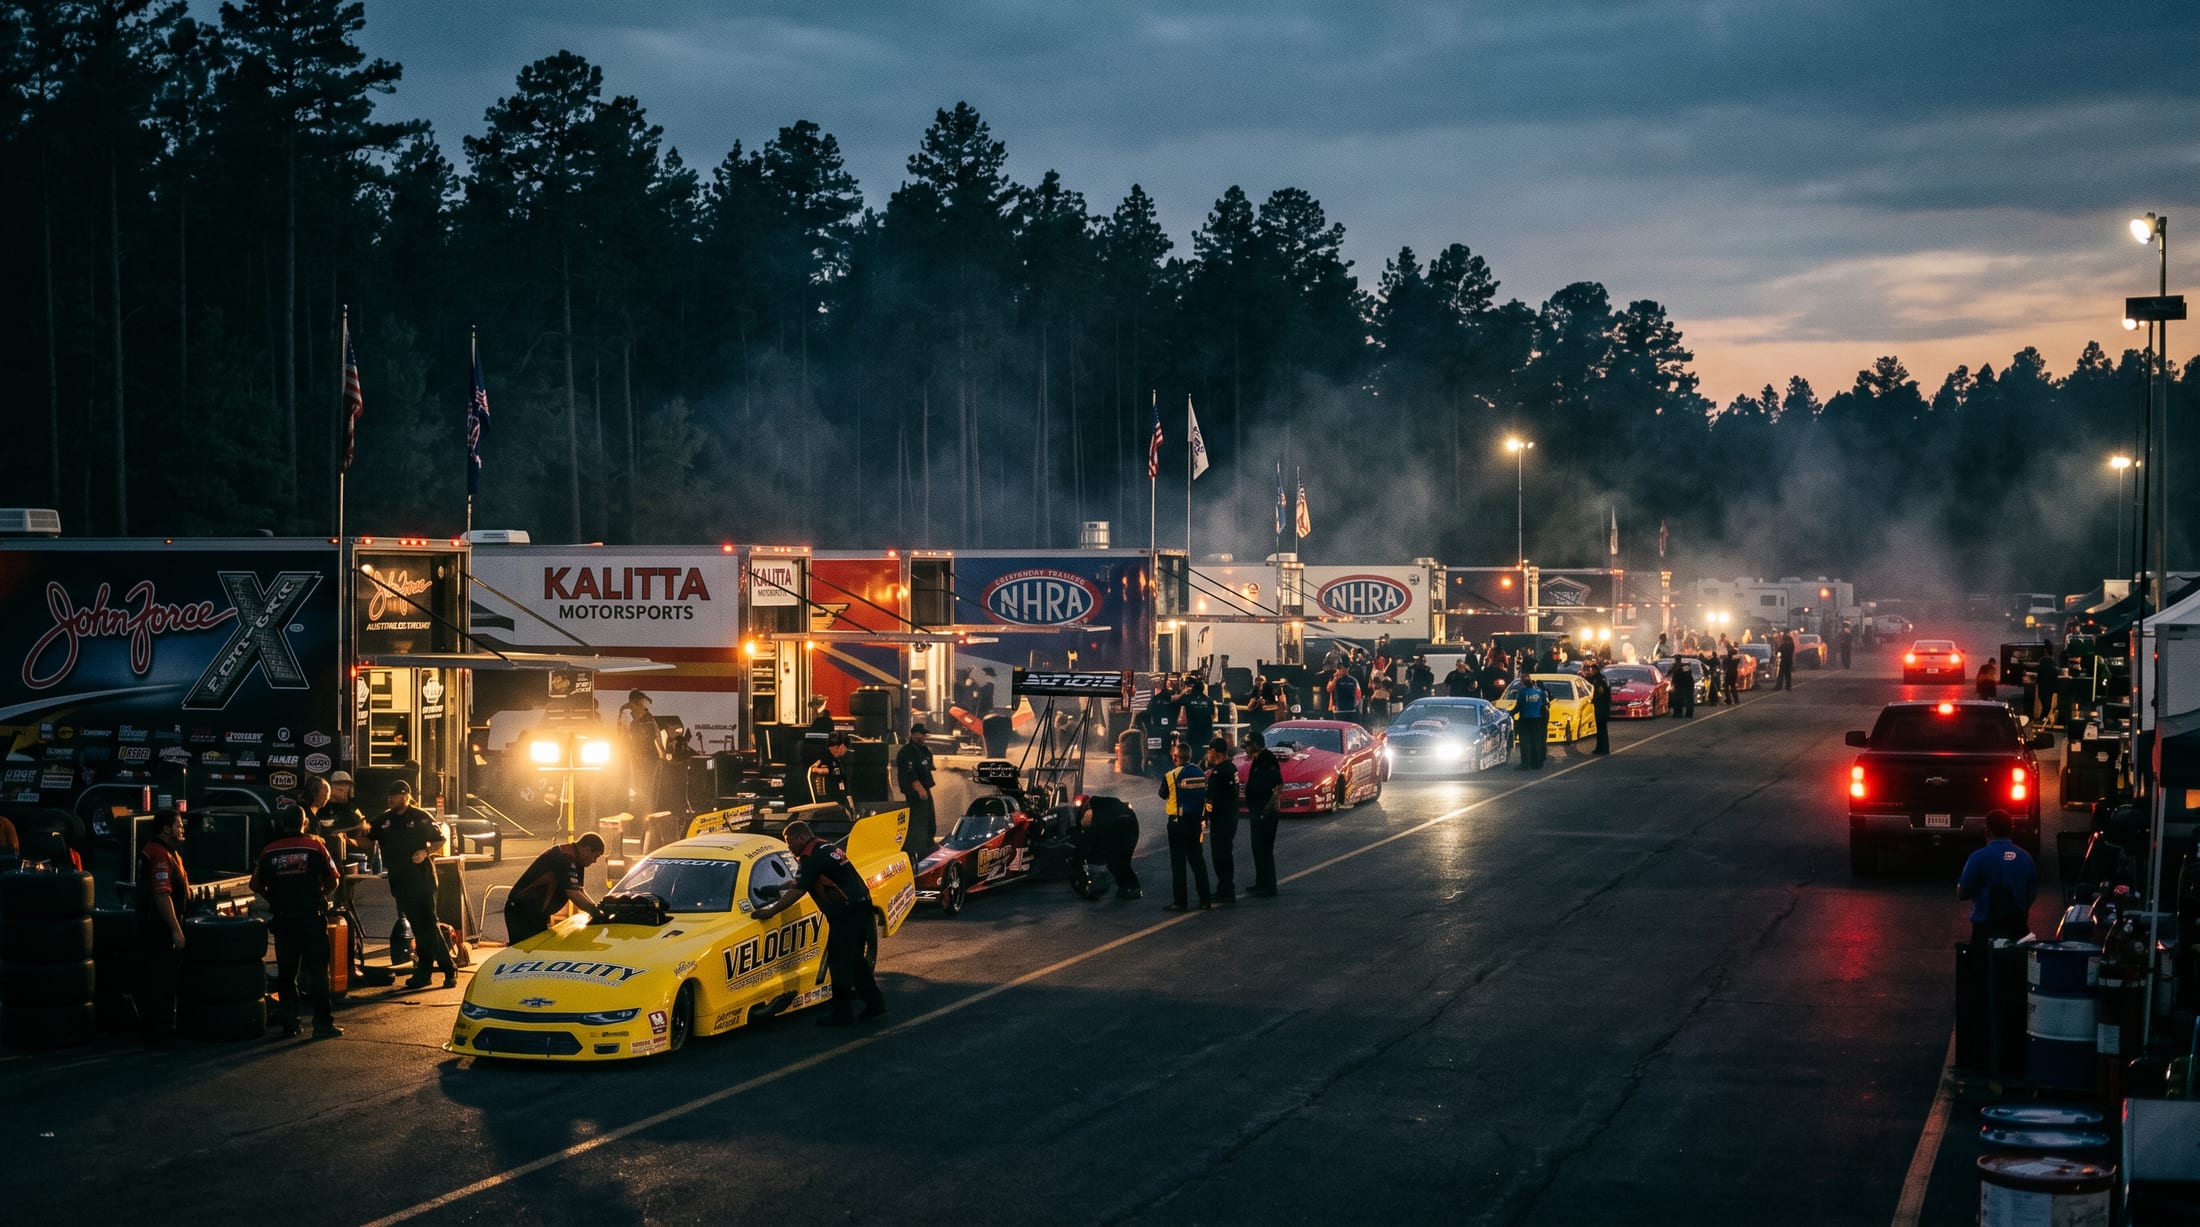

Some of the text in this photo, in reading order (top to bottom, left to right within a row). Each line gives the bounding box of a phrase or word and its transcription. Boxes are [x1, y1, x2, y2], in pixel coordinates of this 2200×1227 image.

[544, 567, 711, 600] KALITTA
[1331, 583, 1398, 613] NHRA
[559, 605, 693, 620] MOTORSPORTS
[1000, 581, 1083, 621] NHRA
[722, 912, 825, 982] VELOCITY
[493, 960, 646, 982] VELOCITY
